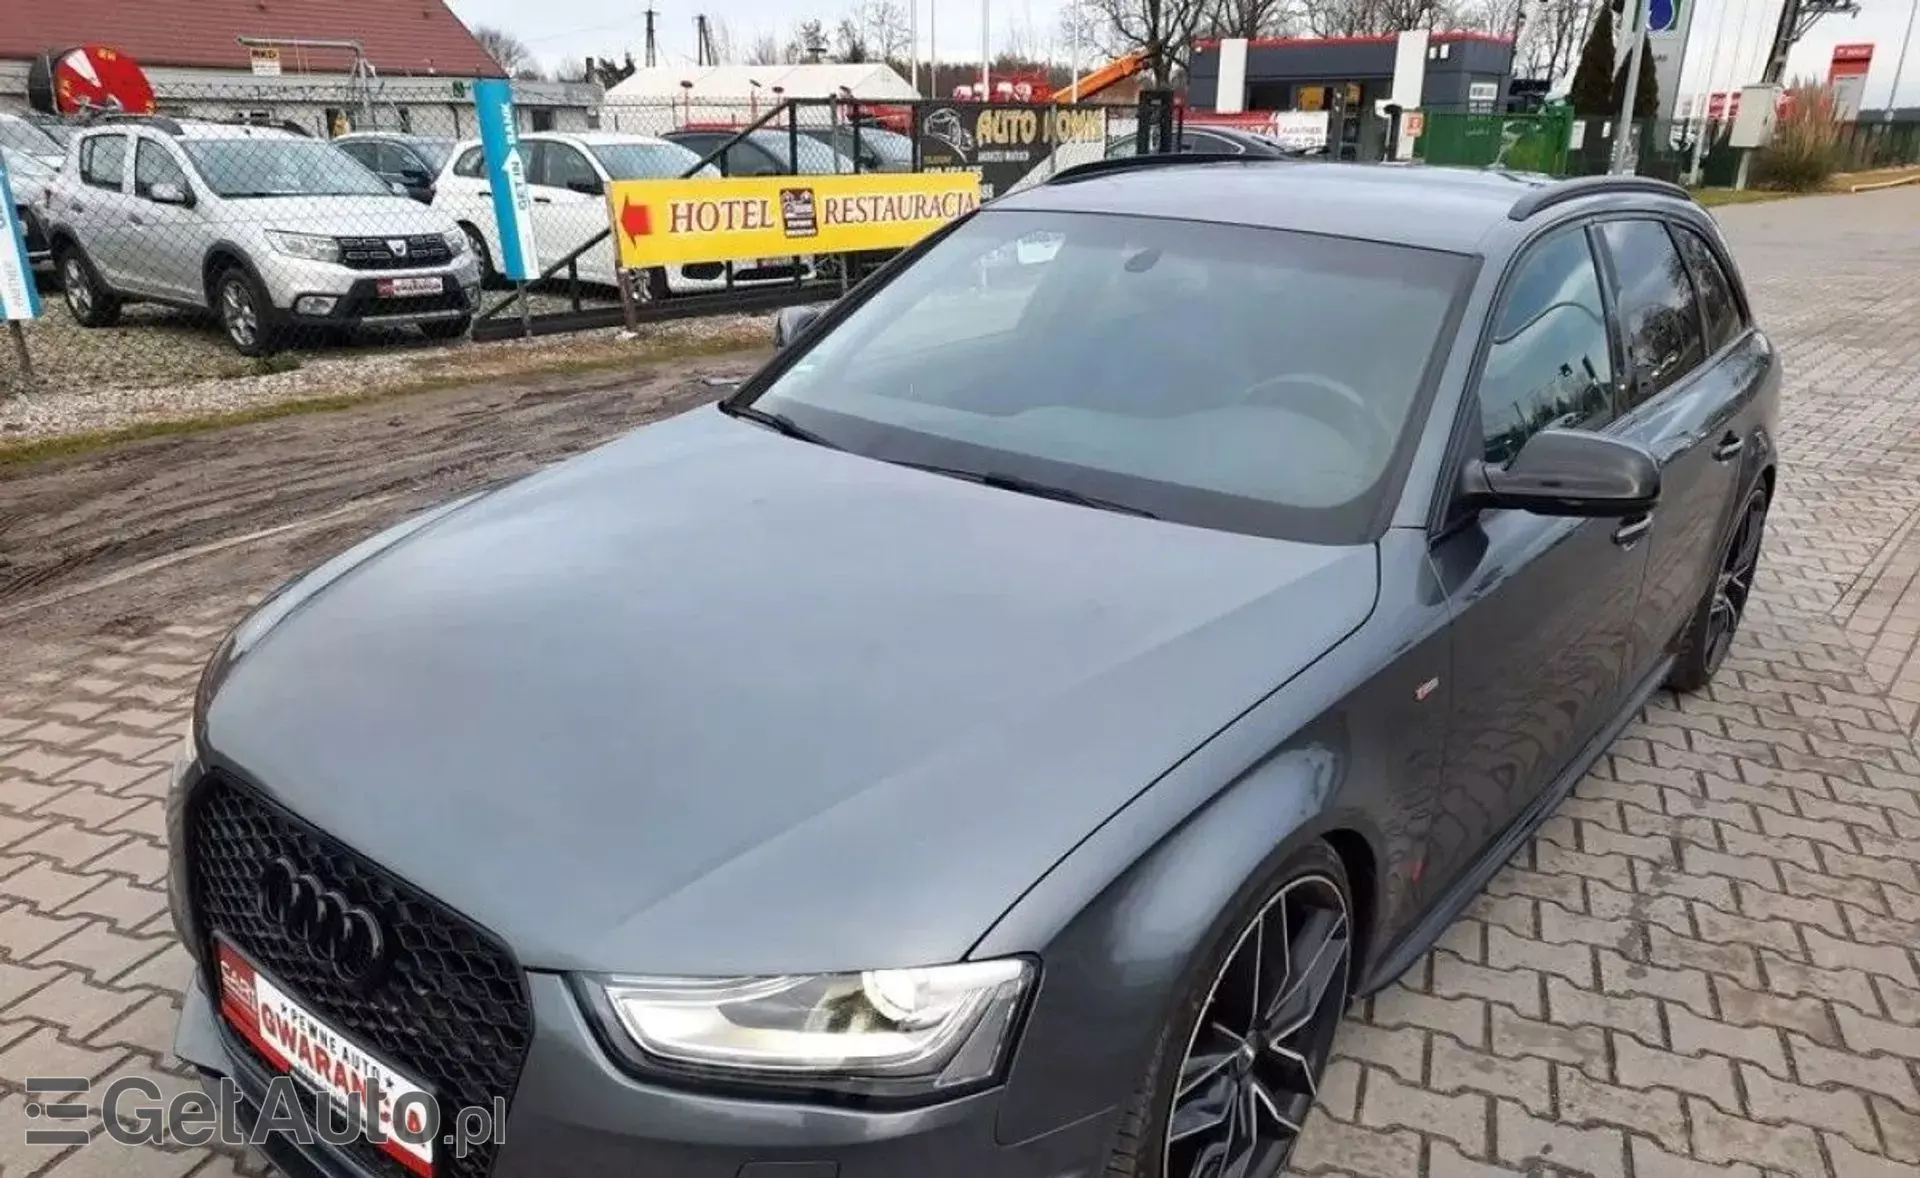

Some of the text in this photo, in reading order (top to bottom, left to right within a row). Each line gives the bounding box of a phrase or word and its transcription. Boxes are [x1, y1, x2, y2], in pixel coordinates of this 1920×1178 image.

[976, 109, 1038, 147] AUTO
[668, 198, 775, 234] HOTEL
[261, 1001, 423, 1134] GWARANA
[290, 1006, 382, 1083] PEWNE AUTO
